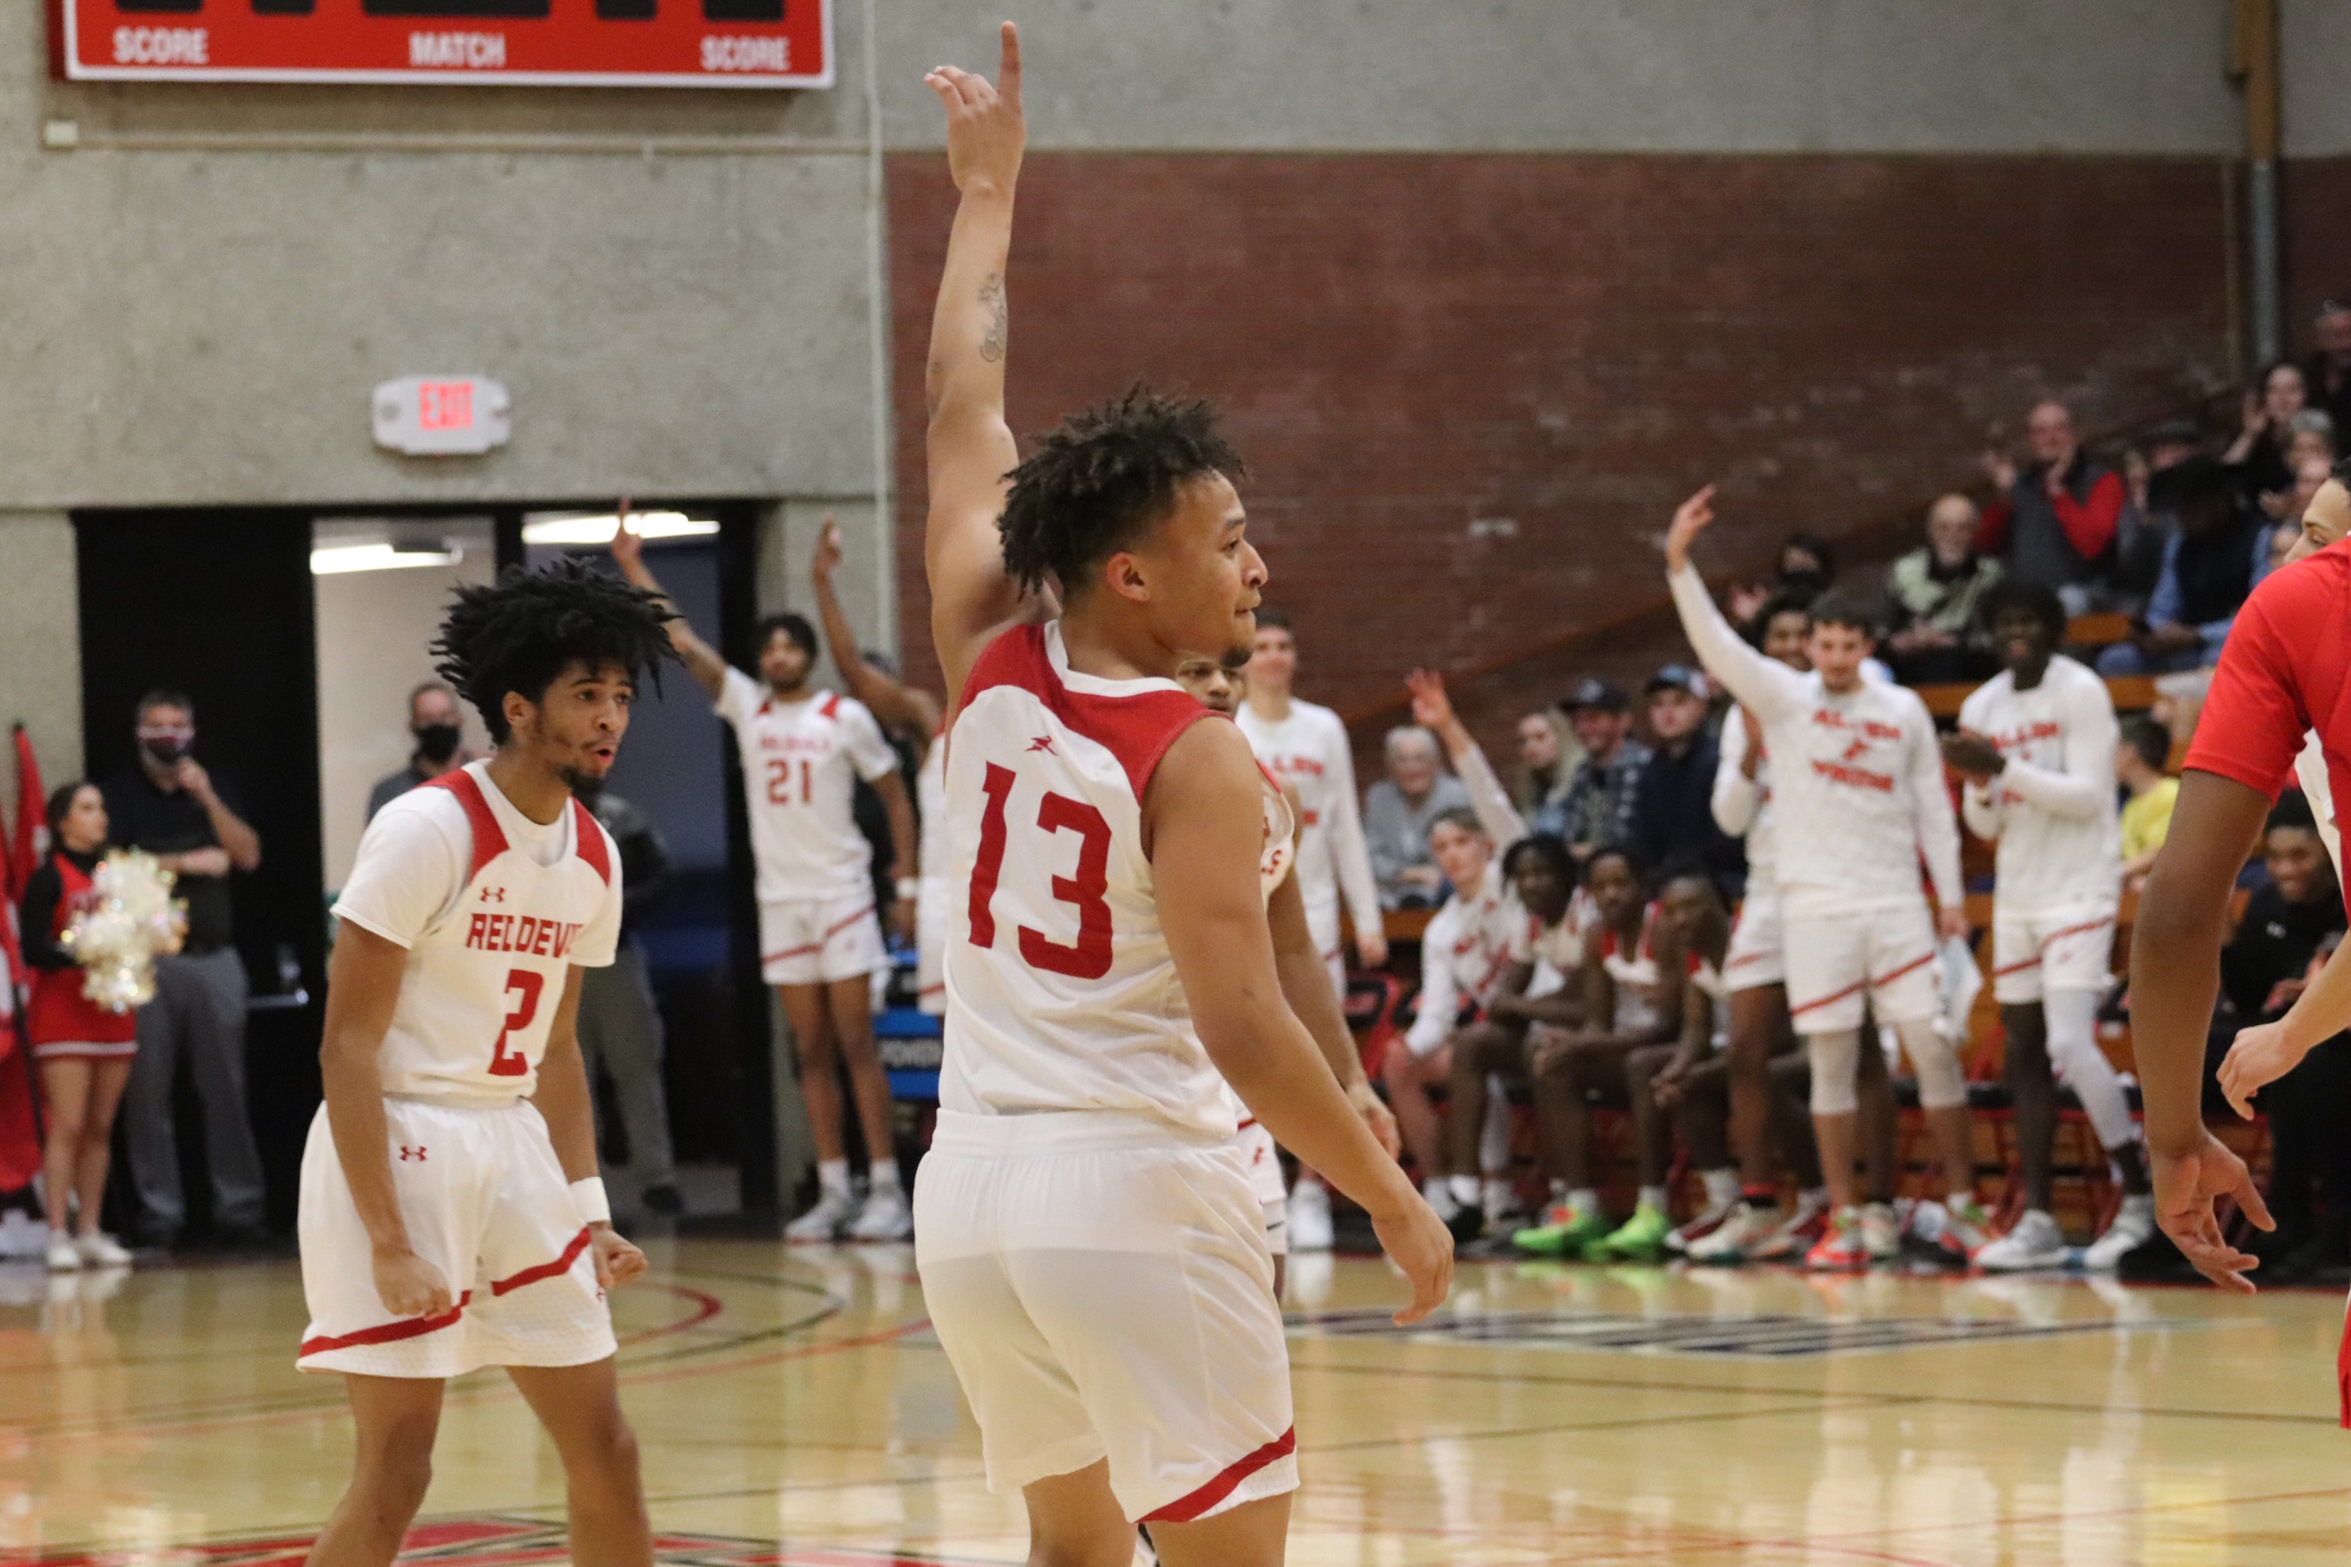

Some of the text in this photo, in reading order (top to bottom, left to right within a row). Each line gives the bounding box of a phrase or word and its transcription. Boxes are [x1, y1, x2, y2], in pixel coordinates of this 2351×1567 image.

[113, 27, 208, 64] SCORE
[409, 32, 506, 67] MATCH
[700, 36, 789, 71] SCORE
[419, 382, 473, 430] EXIT
[767, 759, 811, 804] 21
[968, 760, 1114, 980] 13
[488, 968, 544, 1076] 2
